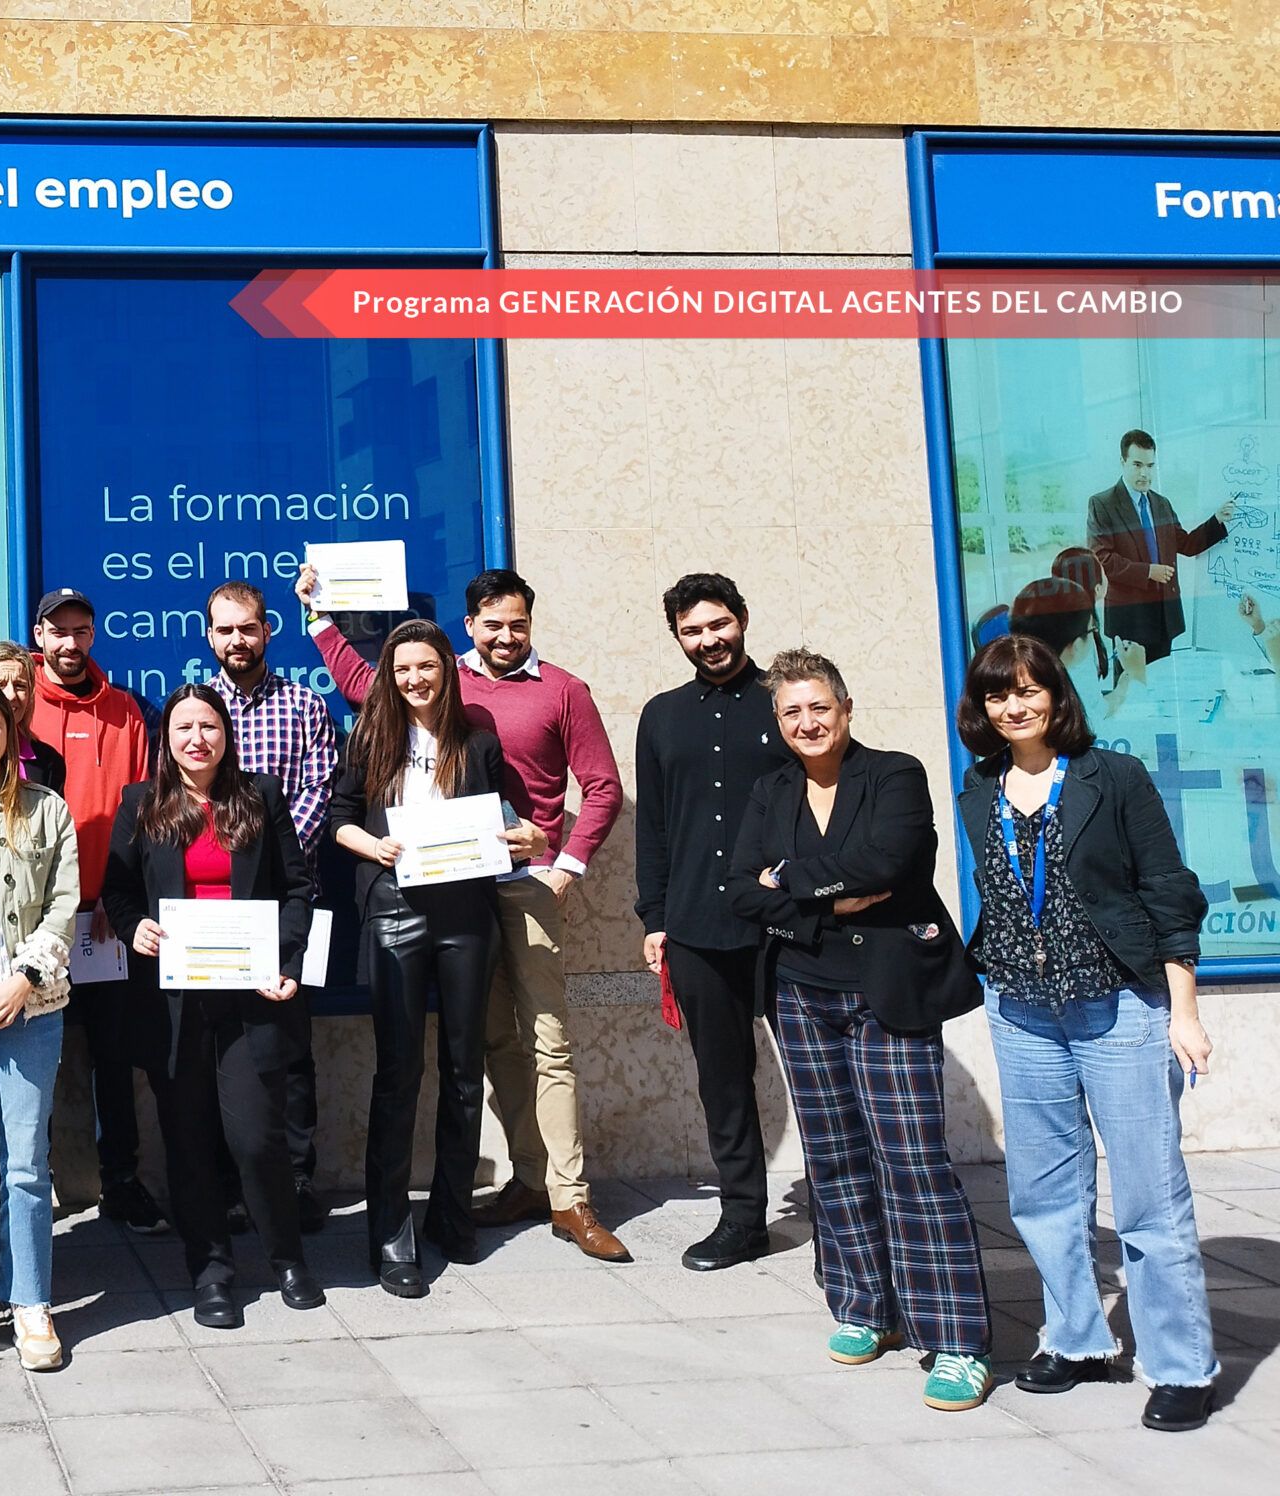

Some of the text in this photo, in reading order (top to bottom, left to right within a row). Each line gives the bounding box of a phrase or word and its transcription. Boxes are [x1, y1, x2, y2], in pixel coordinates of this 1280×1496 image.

[35, 169, 233, 218] empleo
[1155, 182, 1280, 219] Form
[104, 483, 409, 522] La formación
[102, 552, 153, 580] es
[167, 541, 205, 580] el
[103, 609, 283, 639] camo
[80, 932, 93, 957] atu
